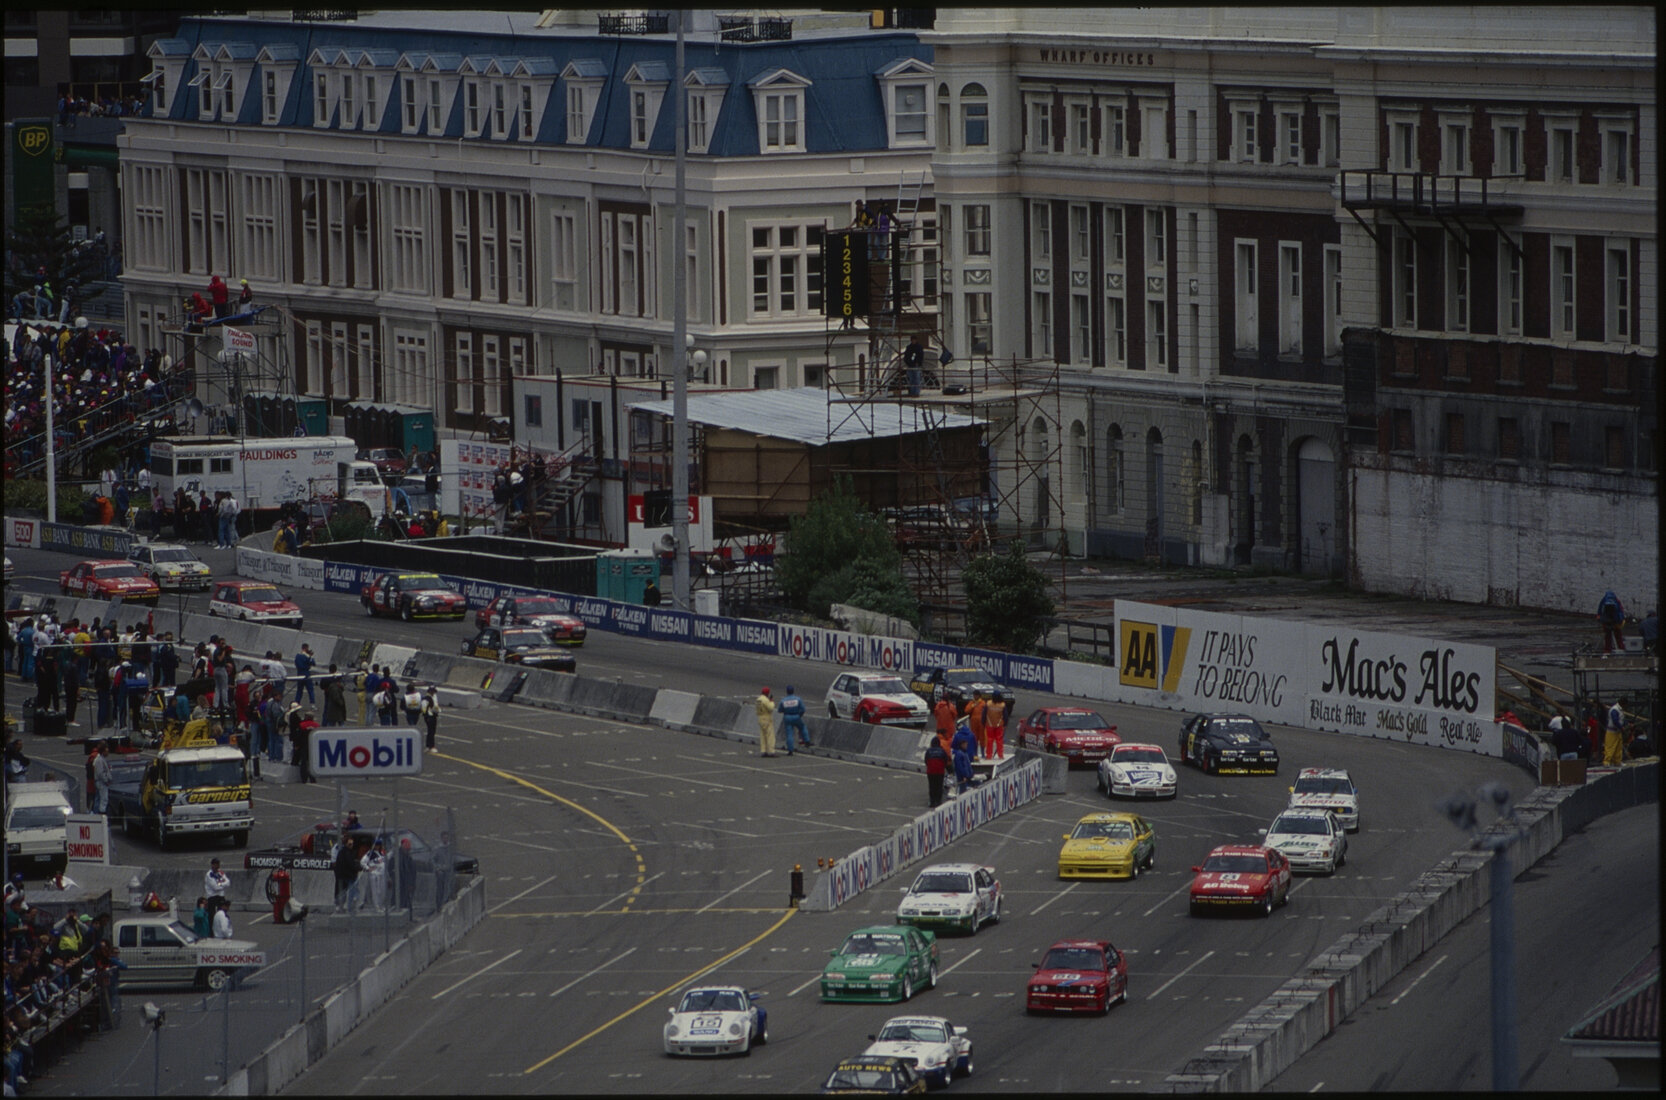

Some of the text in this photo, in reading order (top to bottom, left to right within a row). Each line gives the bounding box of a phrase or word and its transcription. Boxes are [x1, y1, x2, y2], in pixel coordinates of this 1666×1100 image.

[1040, 50, 1154, 66] WHARF OFFICES
[25, 132, 46, 147] BP
[326, 564, 356, 581] FALKEN
[464, 582, 495, 599] FALKEN
[574, 600, 608, 617] FALKEN
[612, 605, 647, 625] FALKEN
[618, 622, 640, 632] TYRES
[651, 614, 689, 635] NISSAN
[694, 620, 731, 641] NISSAN
[736, 625, 775, 646] NISSAN
[781, 627, 820, 658] Mobil
[826, 633, 865, 665] Mobil
[870, 638, 910, 672] Mobil
[1124, 630, 1156, 679] AA
[1201, 630, 1257, 667] IT PAYS
[916, 648, 957, 667] NISSAN
[962, 654, 1003, 677] NISSAN
[1009, 661, 1051, 684] NISSAN
[1194, 665, 1287, 707] TO BELONG
[1322, 636, 1480, 713] Mac's Ales
[1310, 699, 1366, 727] Black Mac
[1407, 712, 1428, 742] Gold
[1440, 717, 1465, 745] Real
[1465, 720, 1482, 743] Ale
[319, 738, 413, 768] Mobil
[1002, 770, 1023, 815] Mobil
[1025, 762, 1042, 804] Mobil
[174, 789, 250, 806] Kearney's
[980, 782, 1000, 824] Mobil
[938, 803, 957, 849] Mobil
[959, 793, 979, 837] Mobil
[79, 826, 90, 840] NO
[899, 828, 914, 864] Mobil
[918, 815, 936, 858] Mobil
[68, 843, 103, 858] SMOKING
[250, 857, 331, 869] THOMSON CHEVROLET
[876, 841, 894, 881] Mobil
[830, 862, 849, 908] Mobil
[852, 849, 872, 896] Mobil
[201, 955, 263, 964] NO SMOKING
